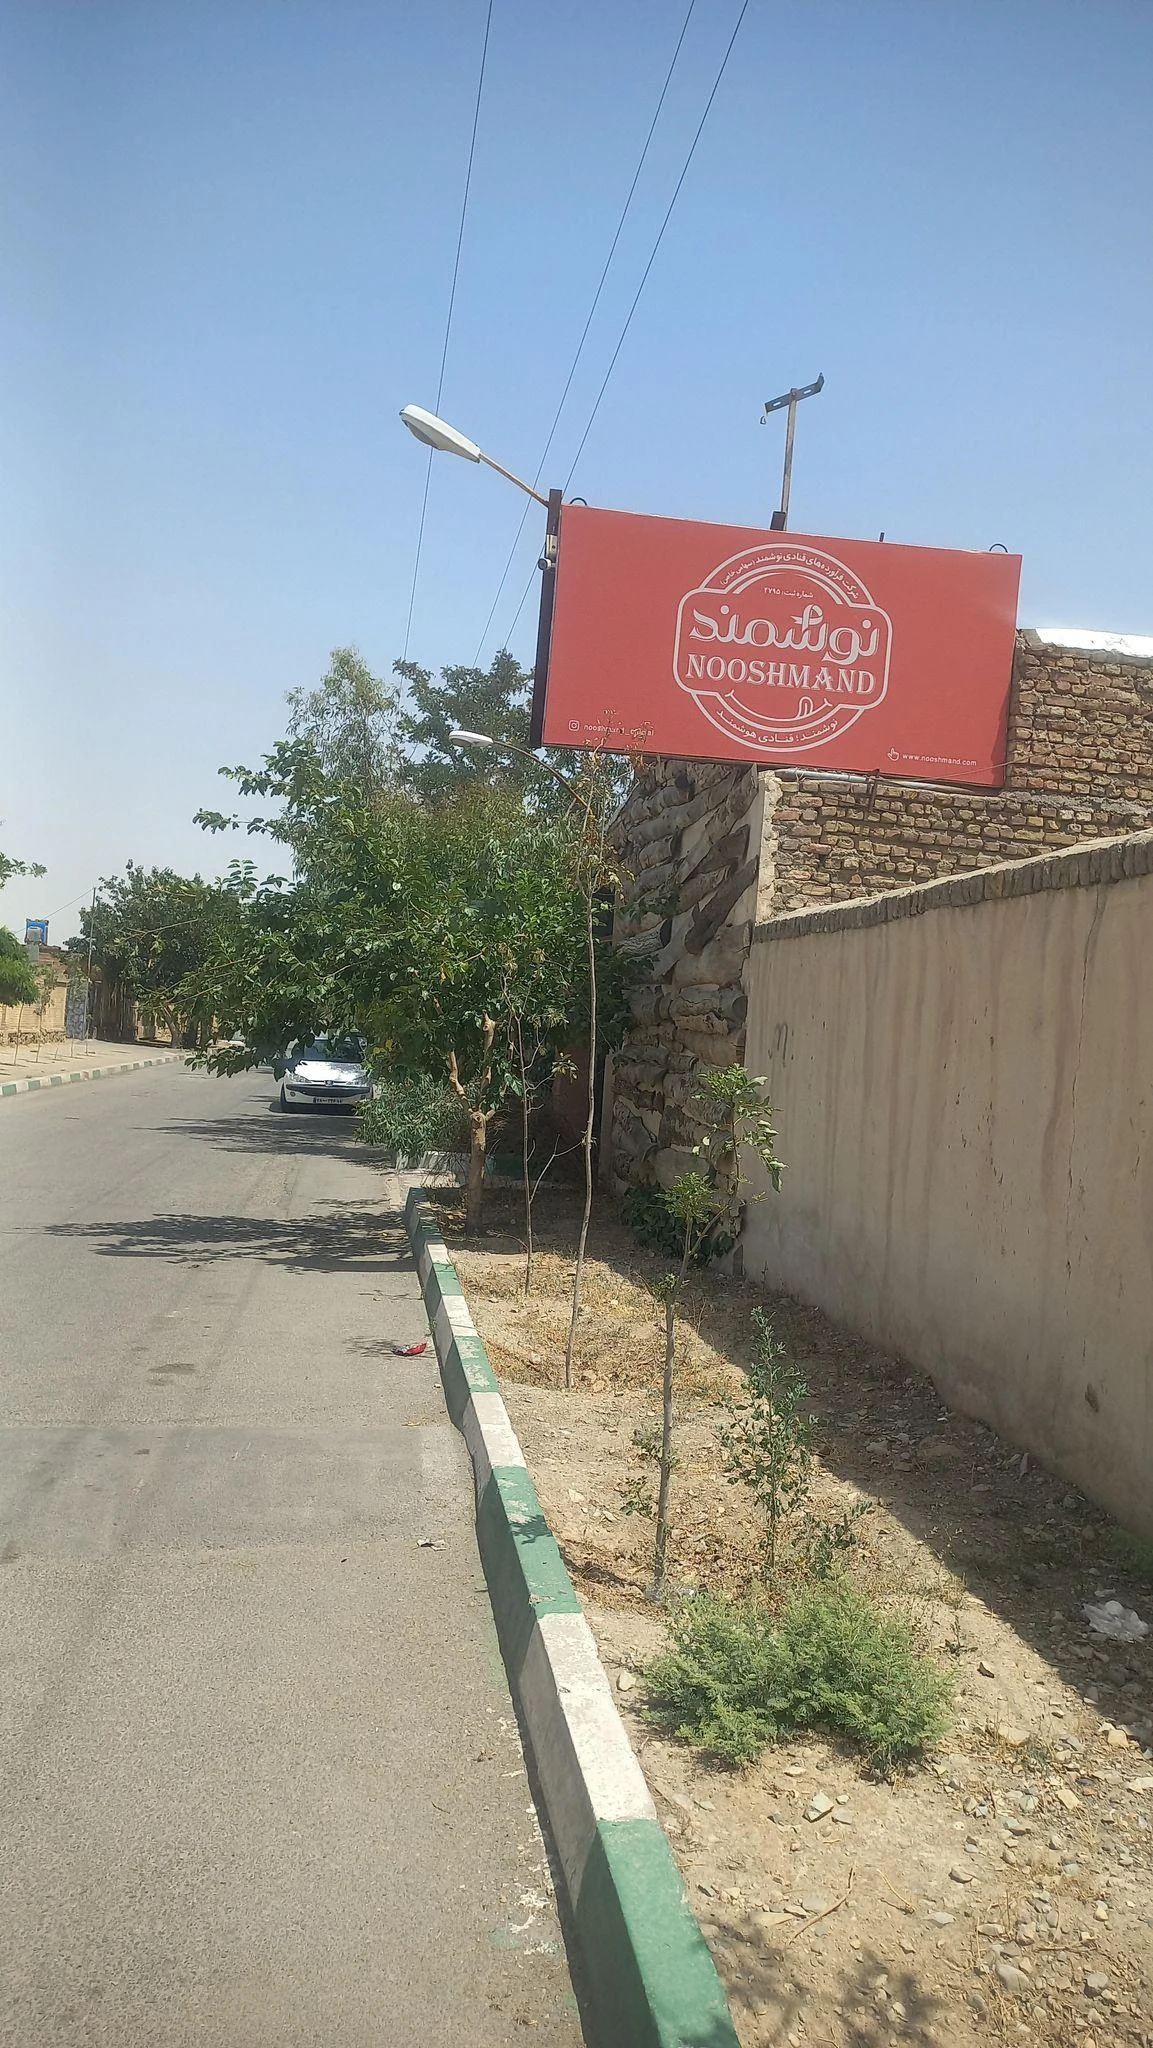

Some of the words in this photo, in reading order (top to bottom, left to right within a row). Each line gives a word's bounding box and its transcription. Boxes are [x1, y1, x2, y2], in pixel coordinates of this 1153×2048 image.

[755, 552, 783, 564] نوشمند
[783, 552, 807, 562] قنادی
[796, 590, 814, 600] شماره
[842, 580, 859, 599] شرکت
[689, 603, 881, 665] نوشمند
[685, 653, 876, 695] NOOSHMAND
[716, 709, 757, 739] هوشمند
[758, 733, 794, 744] قنادی
[901, 753, 977, 766] www.nooshmand.com
